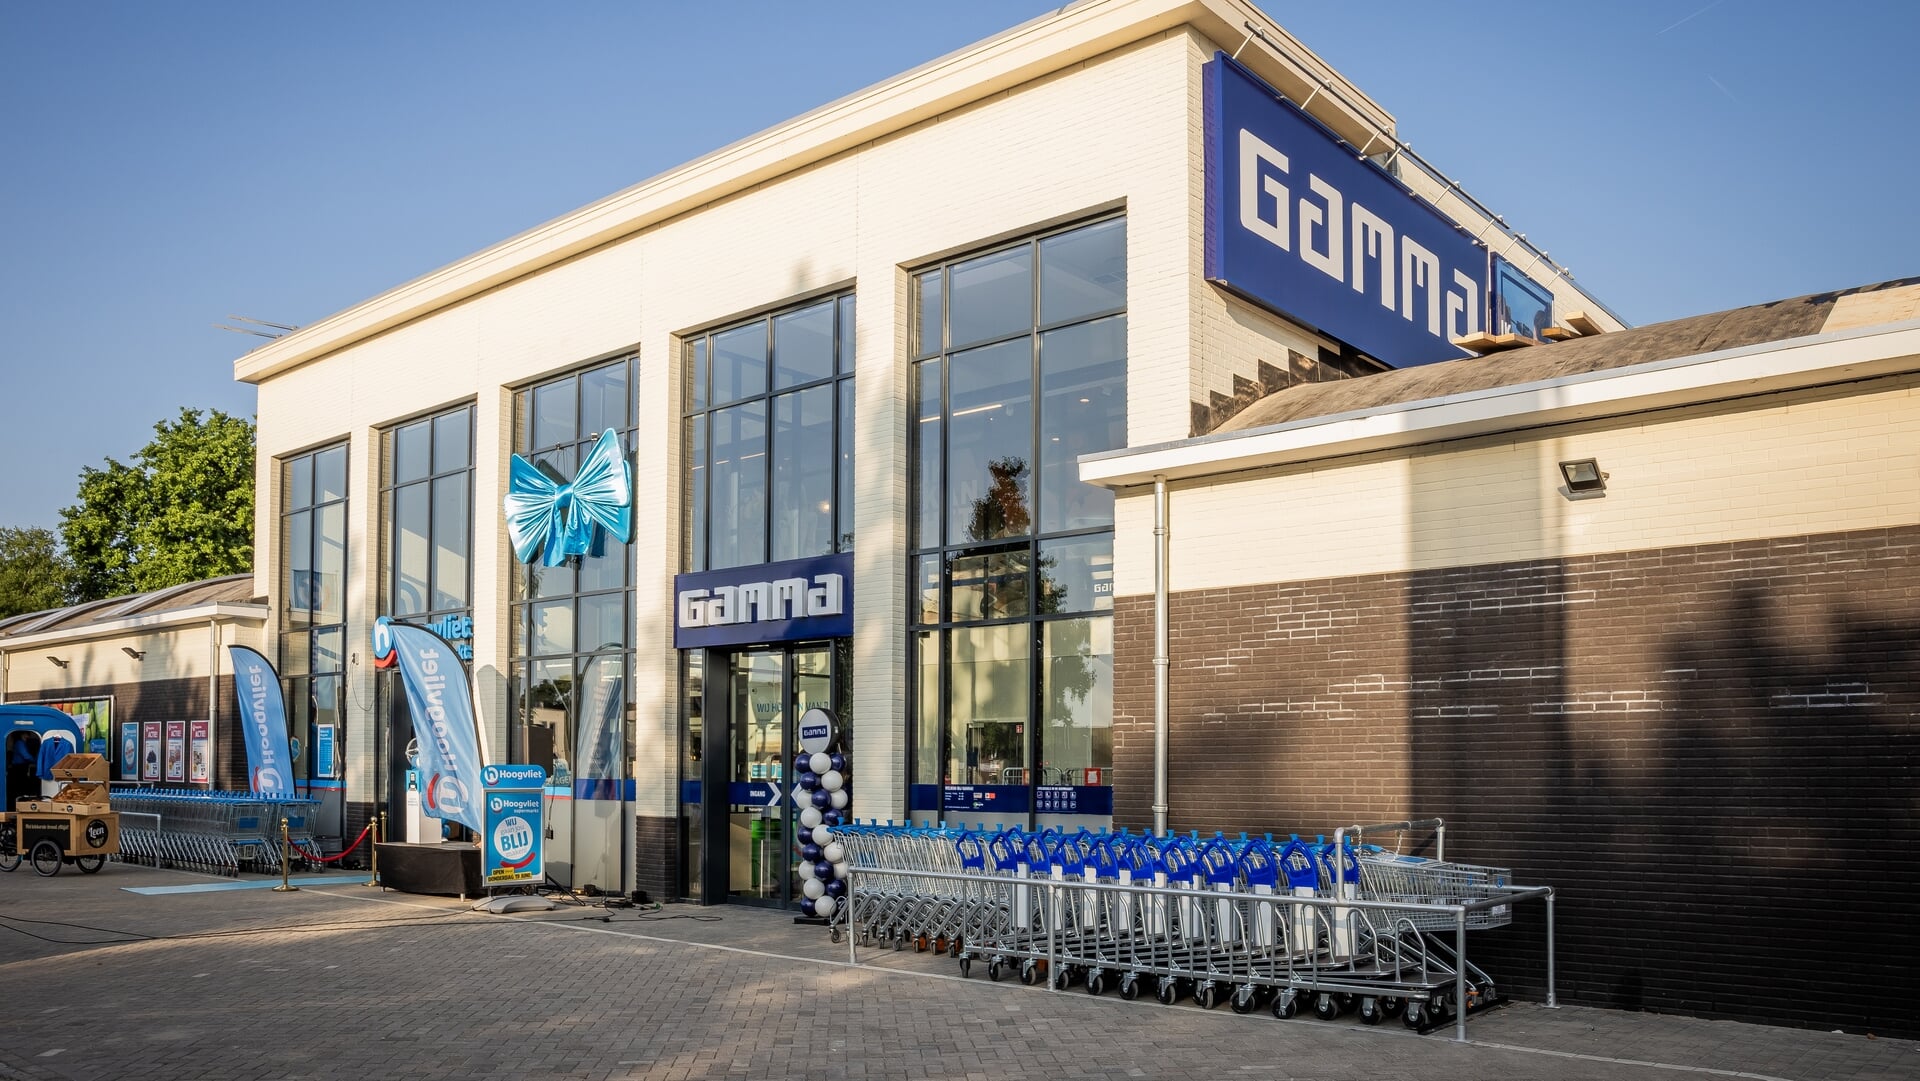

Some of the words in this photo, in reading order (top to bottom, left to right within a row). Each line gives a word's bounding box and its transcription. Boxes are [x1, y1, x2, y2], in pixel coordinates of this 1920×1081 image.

[500, 769, 542, 780] Hoogvliet
[503, 800, 539, 808] Hoogvliet
[501, 830, 529, 851] BLIJ
